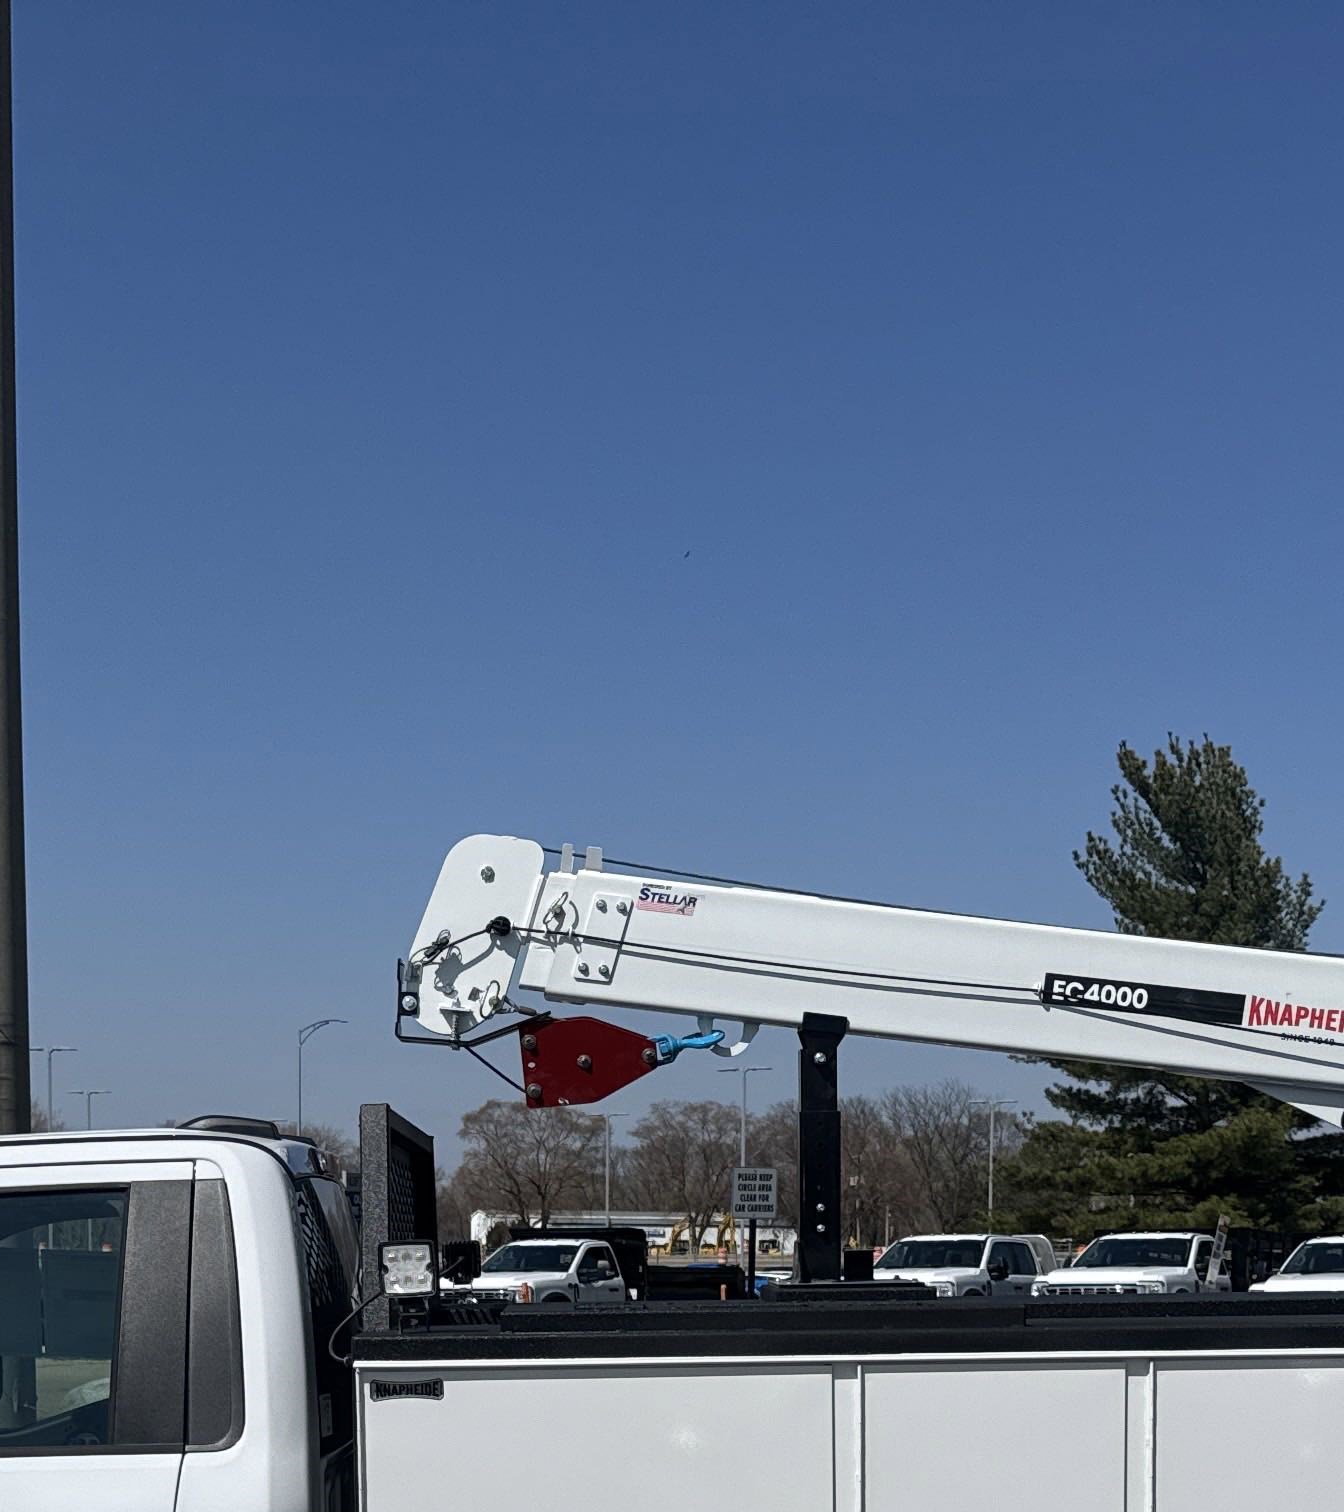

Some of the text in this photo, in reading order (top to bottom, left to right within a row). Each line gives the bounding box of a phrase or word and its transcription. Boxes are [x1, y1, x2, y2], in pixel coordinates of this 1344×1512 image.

[639, 888, 698, 907] STELLAR
[737, 1173, 773, 1181] PLEASE KEEP
[737, 1183, 772, 1191] CIRCLE AREA
[740, 1194, 770, 1202] CLEAR FOR
[735, 1204, 774, 1212] CAR CARRIERS
[375, 1381, 440, 1397] KNAPHEIDE
